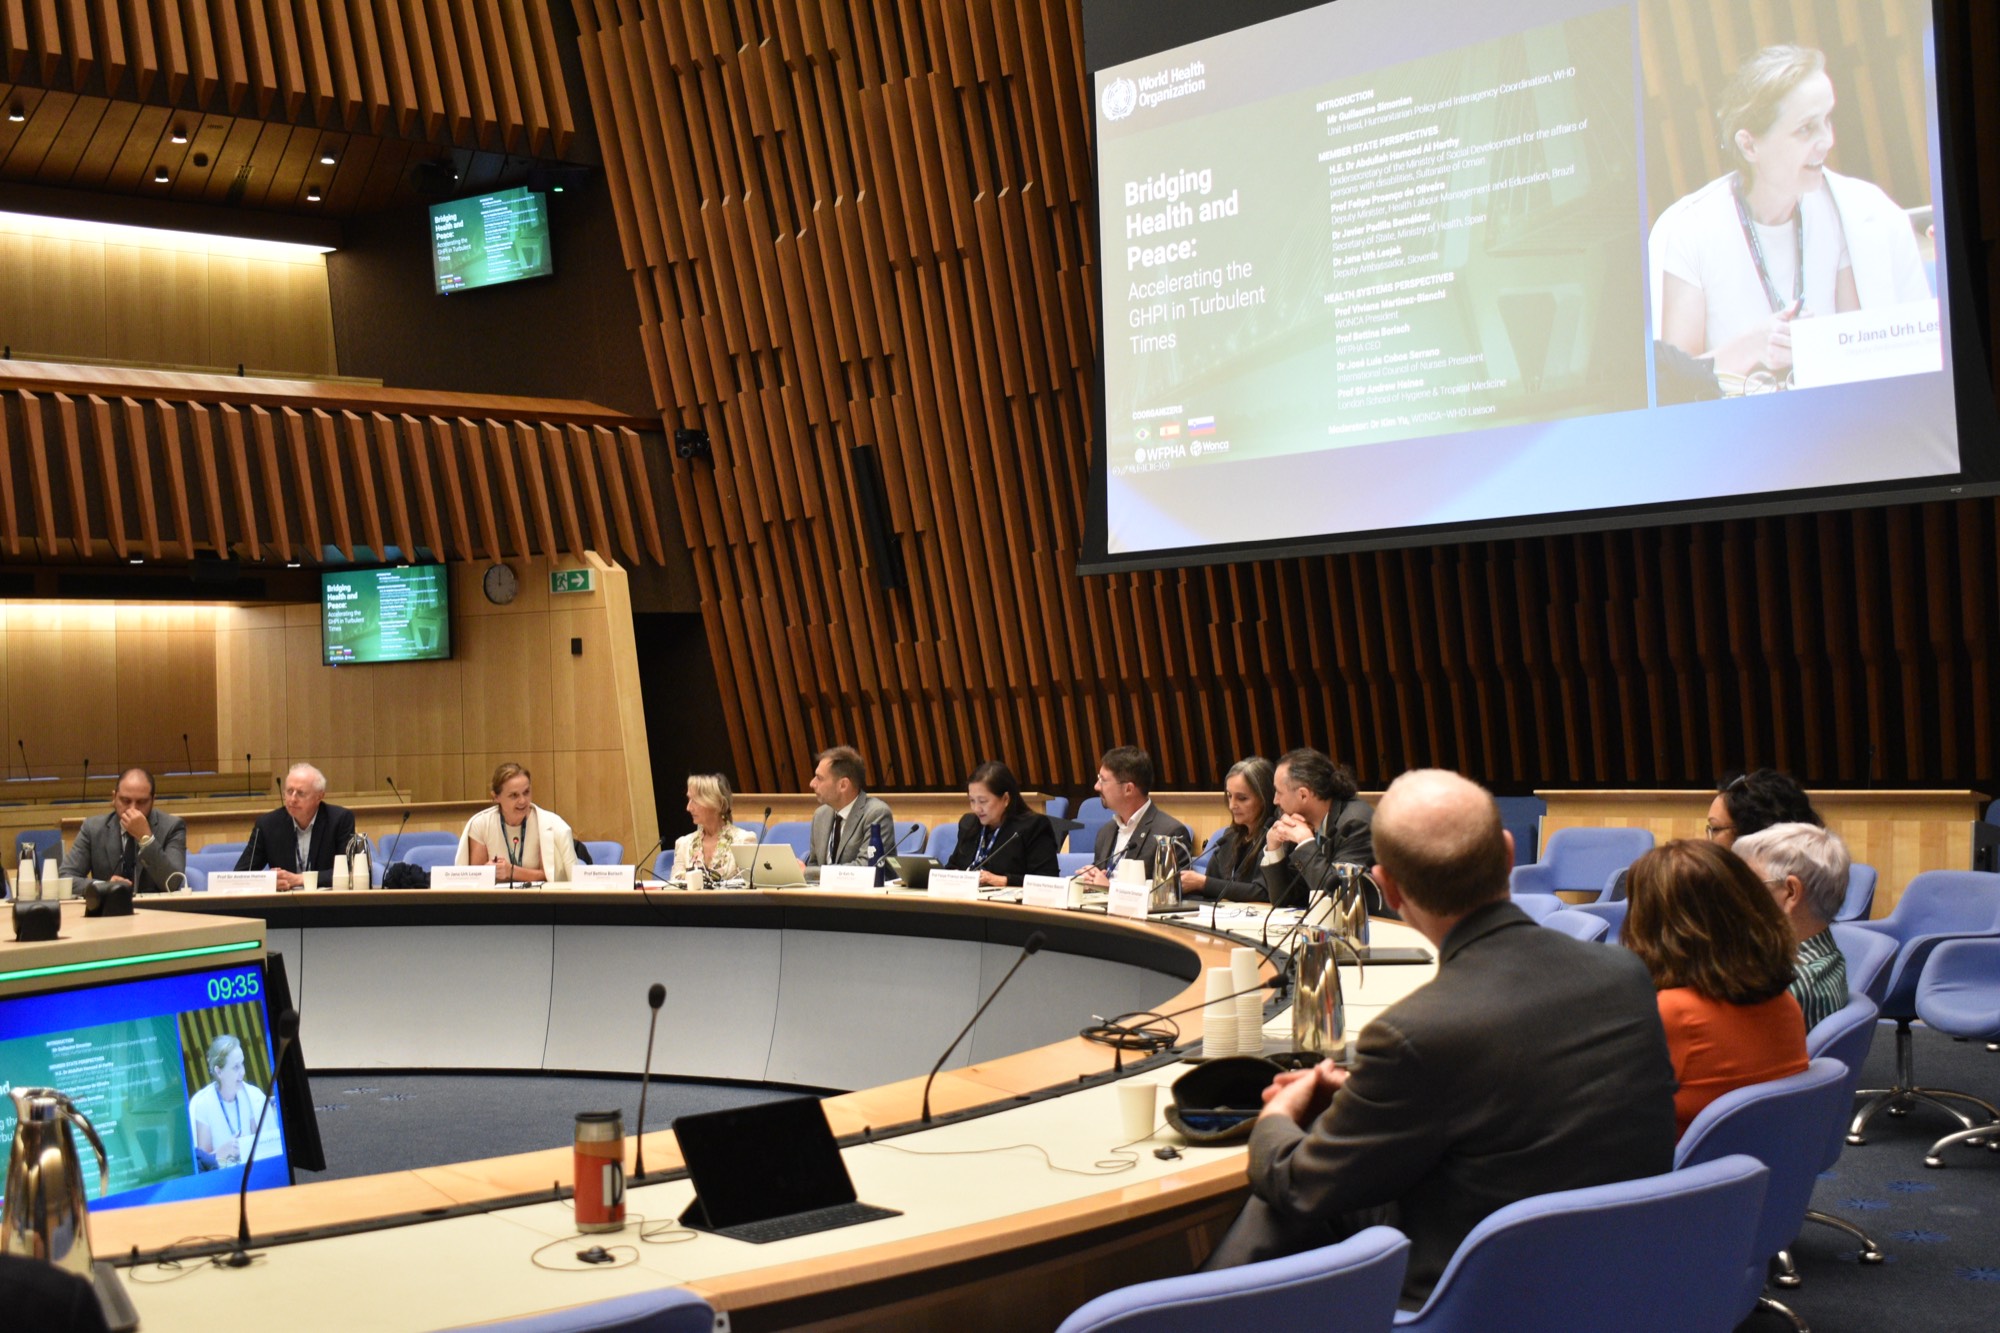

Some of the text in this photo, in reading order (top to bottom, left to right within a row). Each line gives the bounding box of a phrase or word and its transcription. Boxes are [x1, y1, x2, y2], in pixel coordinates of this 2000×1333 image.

[1139, 61, 1204, 90] World Health
[1139, 80, 1205, 106] Organization
[1317, 90, 1373, 111] INTRODUCTION
[1328, 126, 1341, 136] Unit
[1365, 110, 1412, 126] Humanitarian
[1414, 104, 1436, 114] Policy
[1438, 98, 1452, 109] and
[1454, 89, 1498, 104] Interagency
[1554, 67, 1575, 80] WHO
[1327, 115, 1337, 124] Mr
[1319, 126, 1438, 161] MEMBER STATE PERSPECTIVES
[1384, 164, 1391, 174] of
[1393, 163, 1405, 172] the
[1406, 157, 1435, 168] Ministry
[1437, 151, 1444, 162] of
[1447, 147, 1469, 159] Social
[1471, 136, 1521, 153] Development
[1523, 133, 1534, 142] for
[1537, 130, 1549, 139] the
[1551, 124, 1576, 136] affairs
[1579, 119, 1587, 129] of
[1346, 162, 1354, 171] Dr
[1423, 142, 1431, 153] Al
[1125, 169, 1211, 205] Bridging
[1330, 186, 1358, 199] persons
[1360, 181, 1374, 191] with
[1416, 165, 1451, 178] Sultanate
[1452, 161, 1460, 171] of
[1462, 157, 1485, 168] Oman
[1331, 214, 1356, 225] Deputy
[1388, 201, 1412, 212] Health
[1413, 196, 1438, 207] Labour
[1441, 184, 1490, 201] Management
[1493, 179, 1507, 190] and
[1552, 165, 1574, 177] Brazil
[1331, 201, 1346, 213] Prof
[1405, 188, 1414, 197] de
[435, 214, 457, 223] Bridging
[1127, 190, 1238, 238] Health and
[435, 220, 464, 232] Health and
[1332, 239, 1365, 251] Secretary
[1366, 235, 1374, 244] of
[1398, 227, 1426, 238] Ministry
[1428, 222, 1435, 232] of
[1465, 215, 1486, 225] Spain
[1332, 231, 1341, 240] Dr
[1128, 239, 1196, 270] Peace:
[1333, 258, 1341, 267] Dr
[1343, 255, 1361, 264] Jana
[1362, 250, 1375, 260] Urh
[1334, 268, 1358, 279] Deputy
[1408, 252, 1438, 264] Slovenia
[1129, 261, 1252, 300] Accelerating the
[1324, 272, 1454, 303] HEALTH SYSTEMS PERSPECTIVES
[1130, 287, 1264, 327] GHPI in Turbulent
[1335, 306, 1351, 317] Prof
[1335, 311, 1398, 328] WONCA President
[1130, 334, 1176, 353] Times
[1336, 333, 1352, 344] Prof
[1838, 333, 1854, 345] Dr
[1857, 329, 1887, 342] Jana
[1890, 323, 1914, 337] Urh
[1337, 362, 1345, 371] Dr
[1382, 364, 1409, 375] Council
[1411, 362, 1418, 371] of
[1449, 354, 1483, 365] President
[1338, 388, 1353, 398] Prof
[1366, 395, 1390, 405] School
[1392, 393, 1399, 402] of
[1432, 387, 1438, 396] &
[1441, 383, 1470, 394] Tropical
[1472, 379, 1506, 390] Medicine
[1370, 420, 1379, 429] Dr
[1147, 445, 1186, 460] WFPHA
[1203, 441, 1229, 450] Wonca
[327, 584, 351, 592] Bridging
[327, 591, 358, 601] Health and
[208, 973, 259, 1001] 09:35
